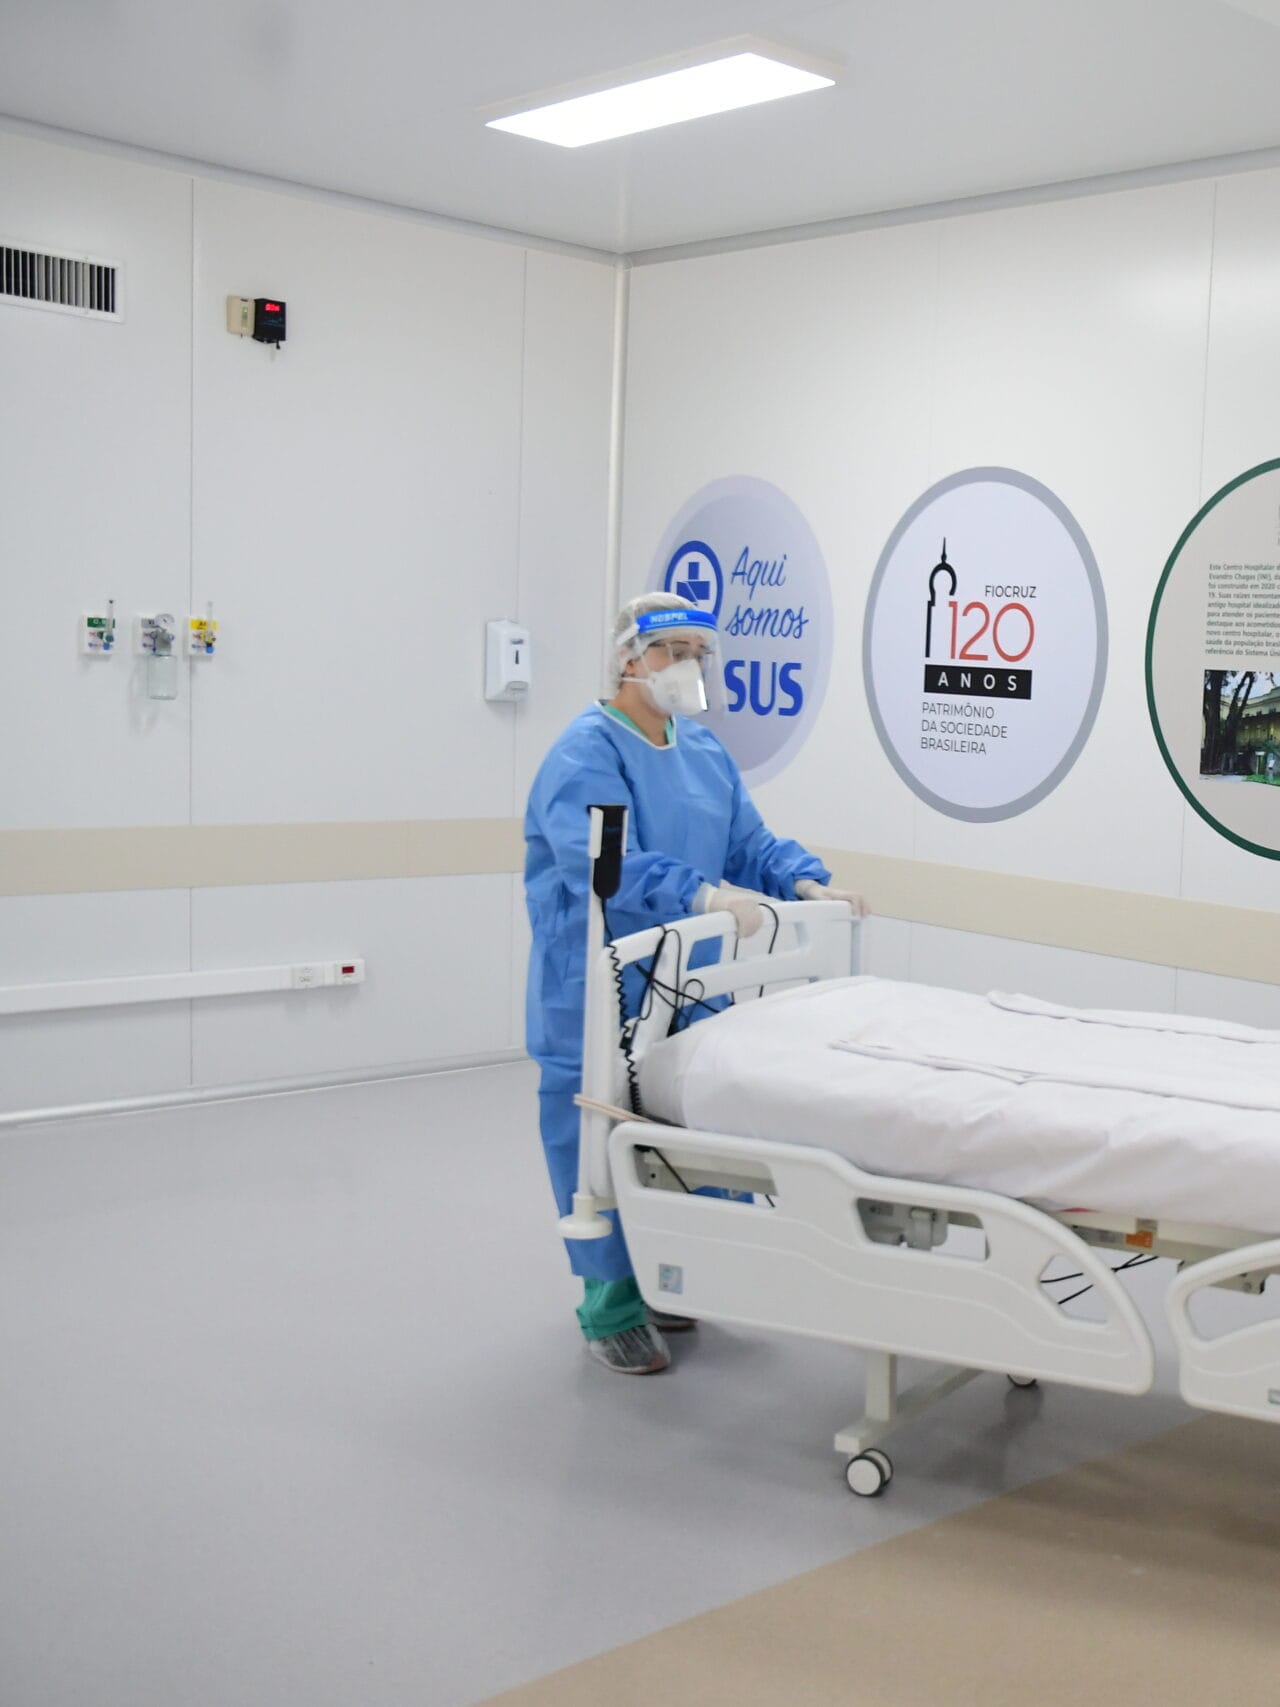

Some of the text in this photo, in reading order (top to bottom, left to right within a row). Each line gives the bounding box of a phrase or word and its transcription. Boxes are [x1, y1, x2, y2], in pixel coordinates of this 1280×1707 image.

[730, 546, 787, 600] Aqui
[984, 585, 1037, 599] FIOCRUZ
[725, 604, 809, 640] somos
[947, 600, 1035, 663] 120
[724, 659, 803, 716] SUS
[938, 671, 1017, 692] ANOS
[922, 701, 995, 719] PATRIMÔNIO
[921, 719, 1008, 739] DA SOCIEDADE
[920, 737, 987, 755] BRASILEIRA
